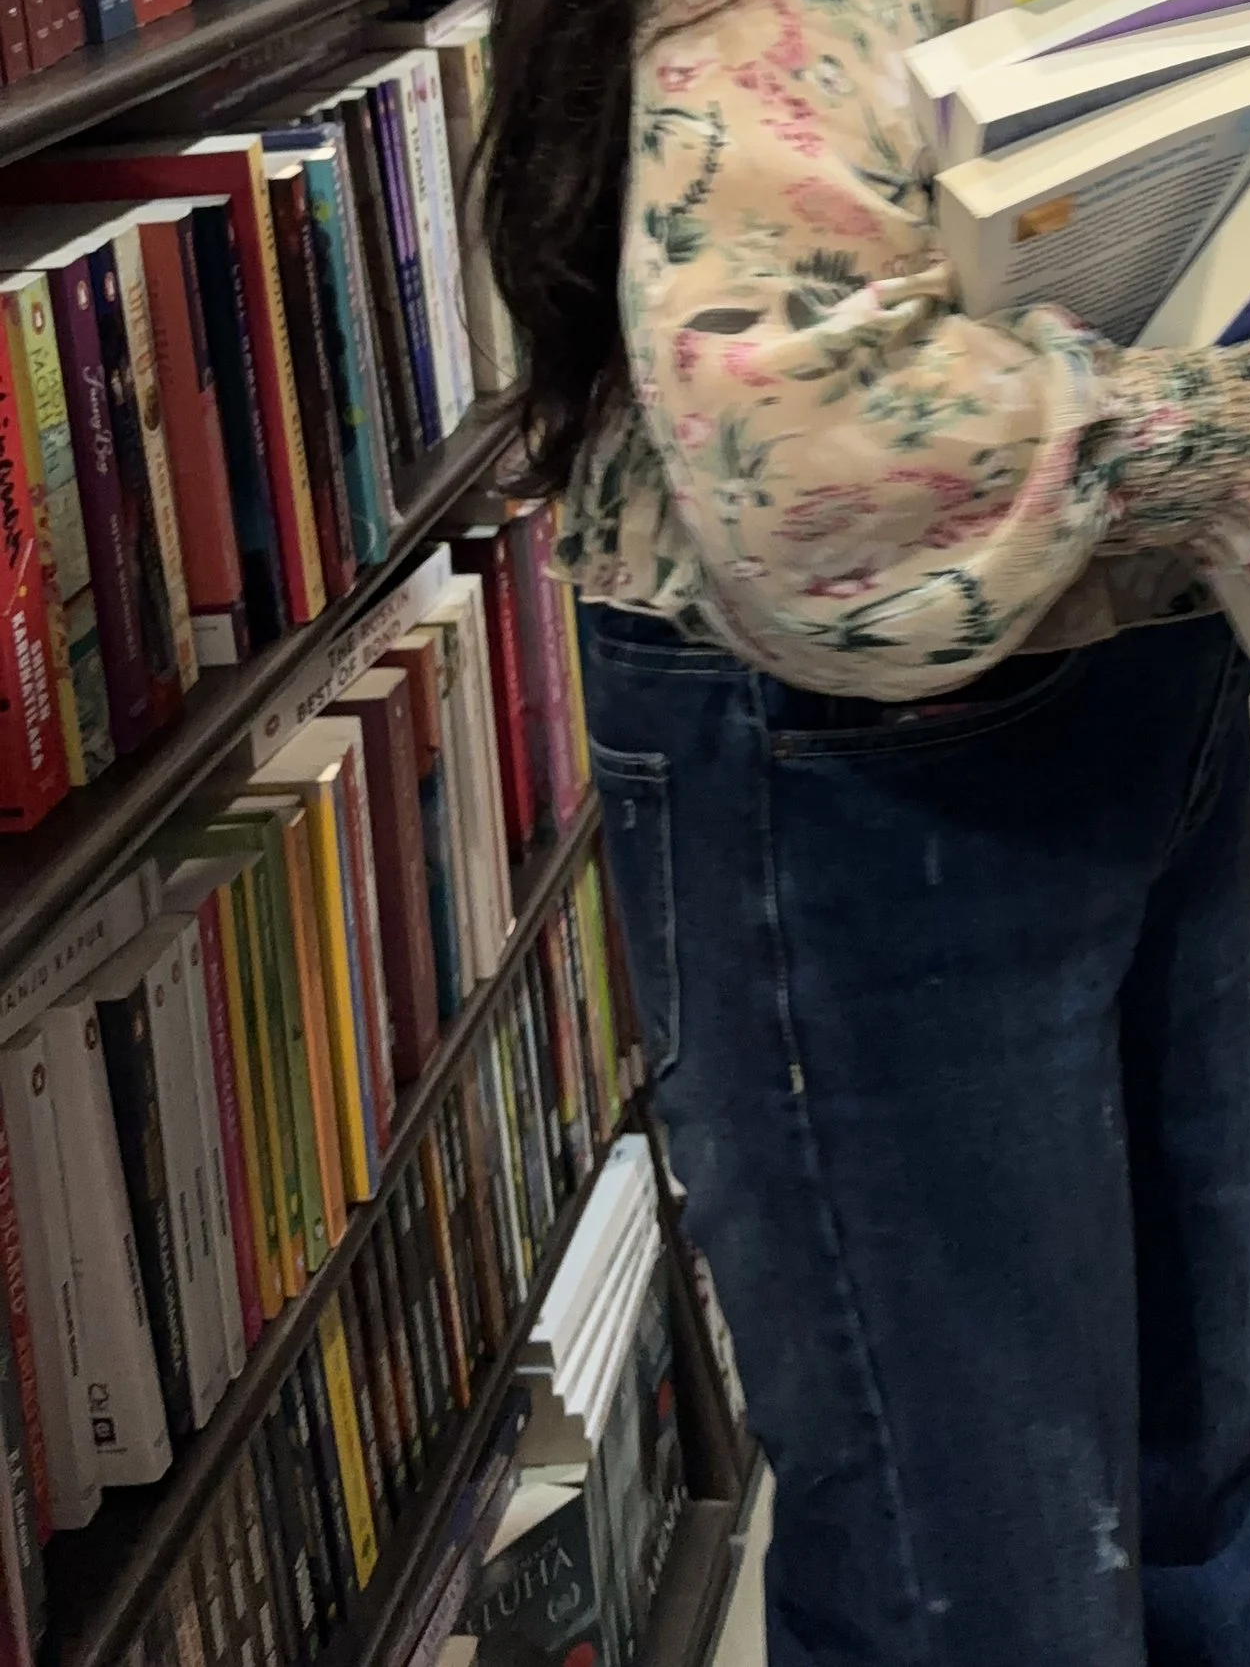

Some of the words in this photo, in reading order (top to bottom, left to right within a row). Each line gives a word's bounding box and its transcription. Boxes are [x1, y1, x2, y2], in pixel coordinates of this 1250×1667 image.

[11, 611, 45, 771] KARUNATILAKA
[30, 637, 52, 724] SHEHAN
[337, 655, 357, 686] OF
